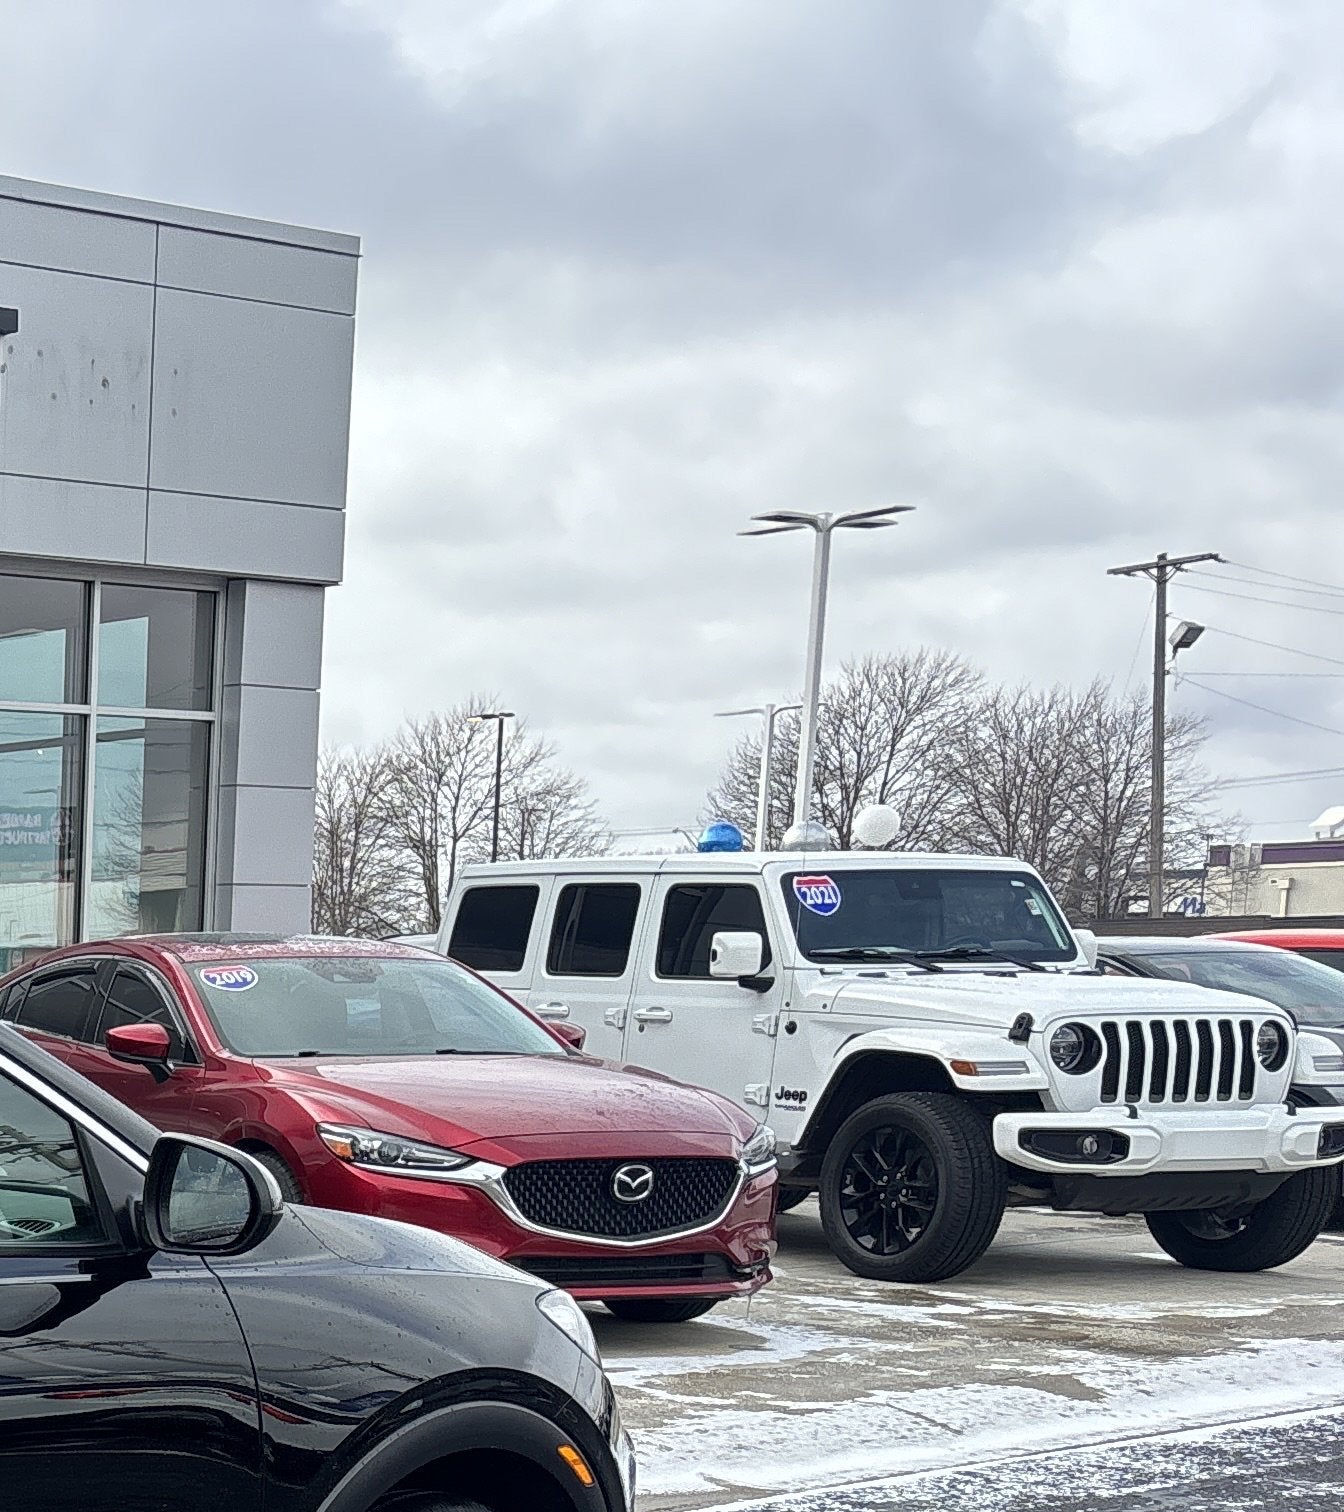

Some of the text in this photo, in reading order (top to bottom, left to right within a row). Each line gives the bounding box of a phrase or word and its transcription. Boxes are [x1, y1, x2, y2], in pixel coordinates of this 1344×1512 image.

[800, 886, 838, 904] 2021
[204, 970, 252, 985] 2019
[774, 1085, 808, 1105] Jeep
